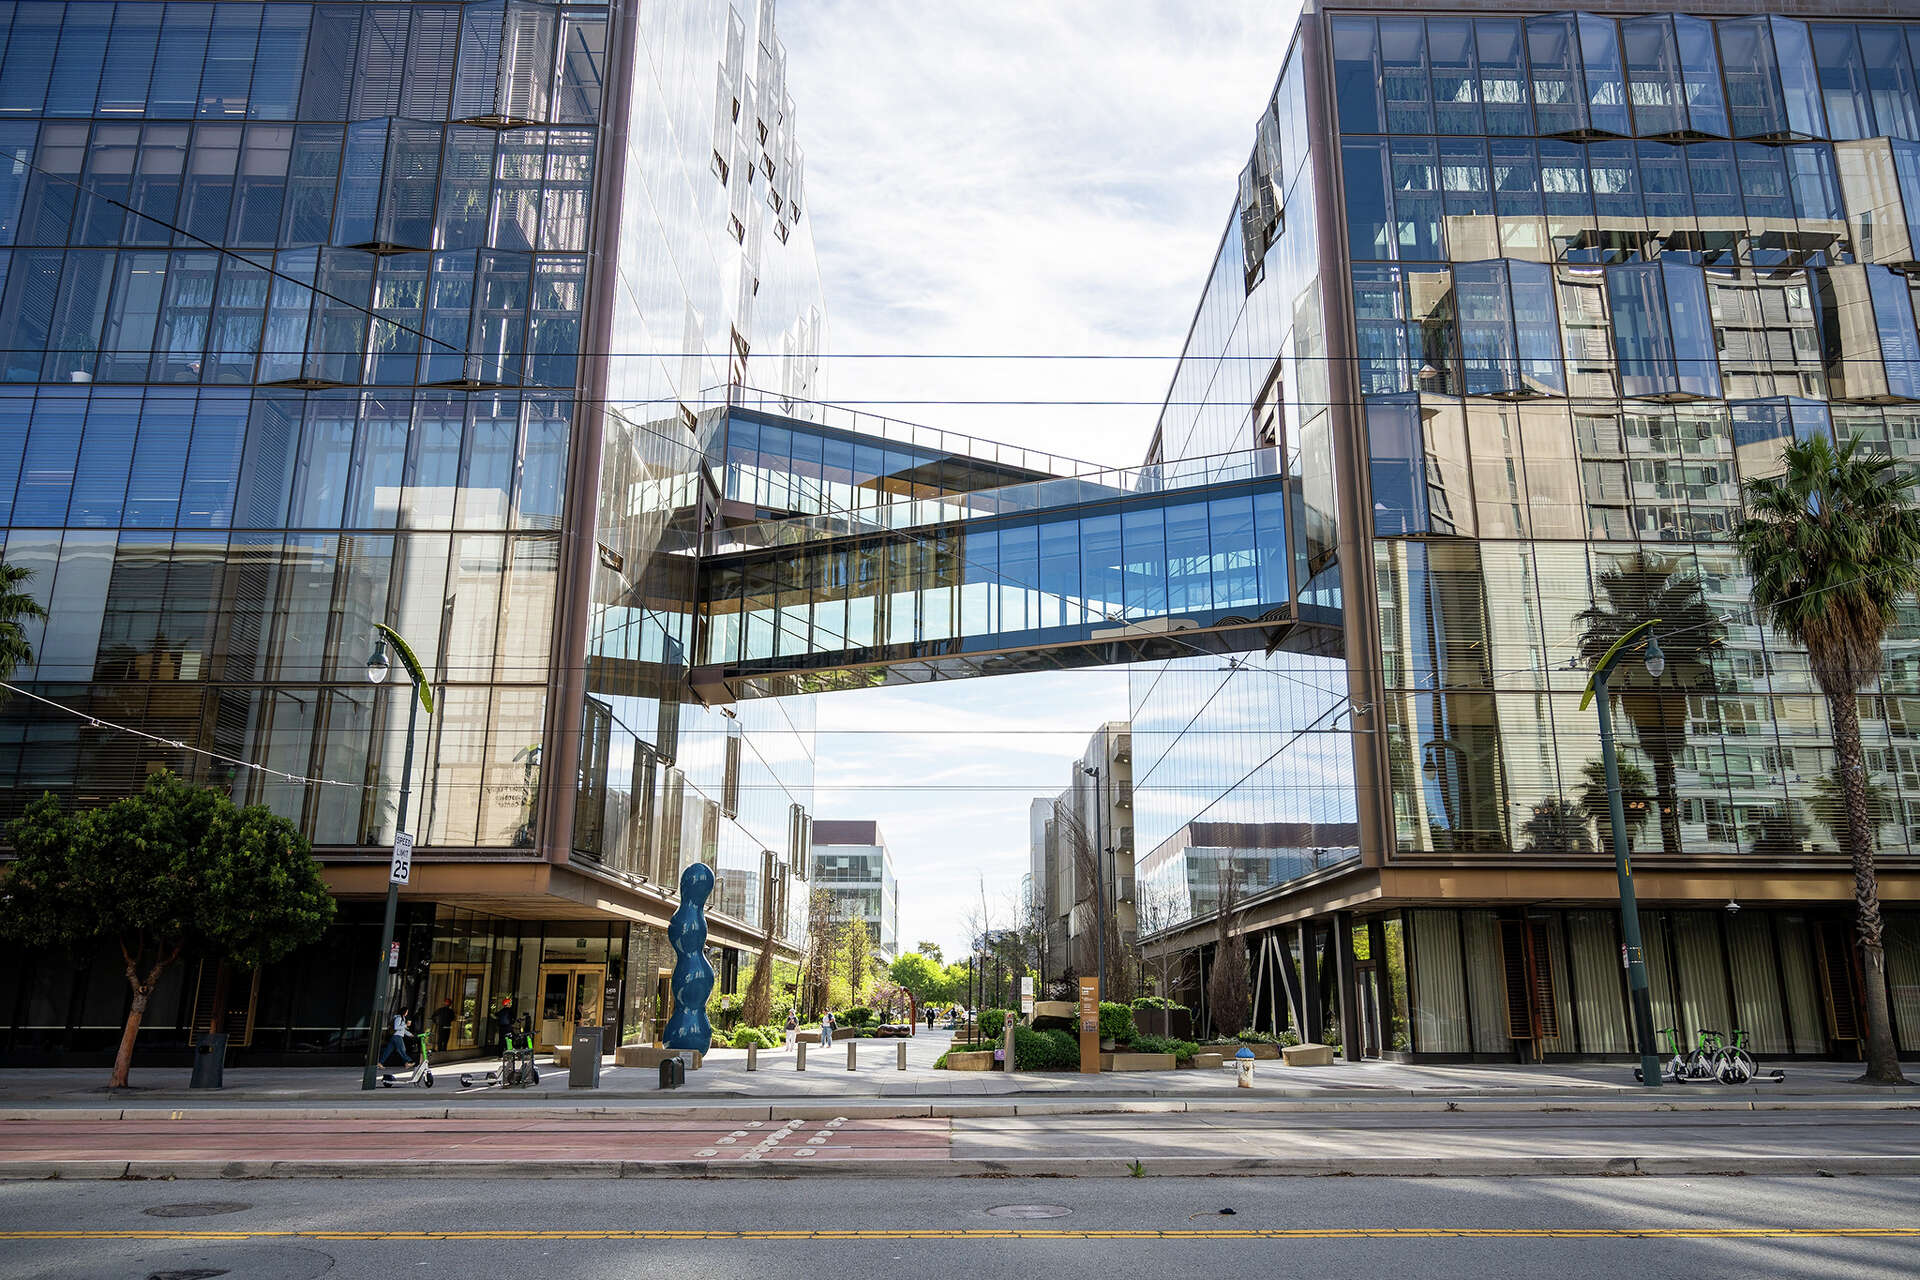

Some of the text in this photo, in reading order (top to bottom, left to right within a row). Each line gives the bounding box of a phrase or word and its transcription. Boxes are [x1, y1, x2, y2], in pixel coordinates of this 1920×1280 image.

[397, 836, 411, 847] SPEED
[396, 849, 409, 858] LIMIT
[393, 860, 408, 879] 25
